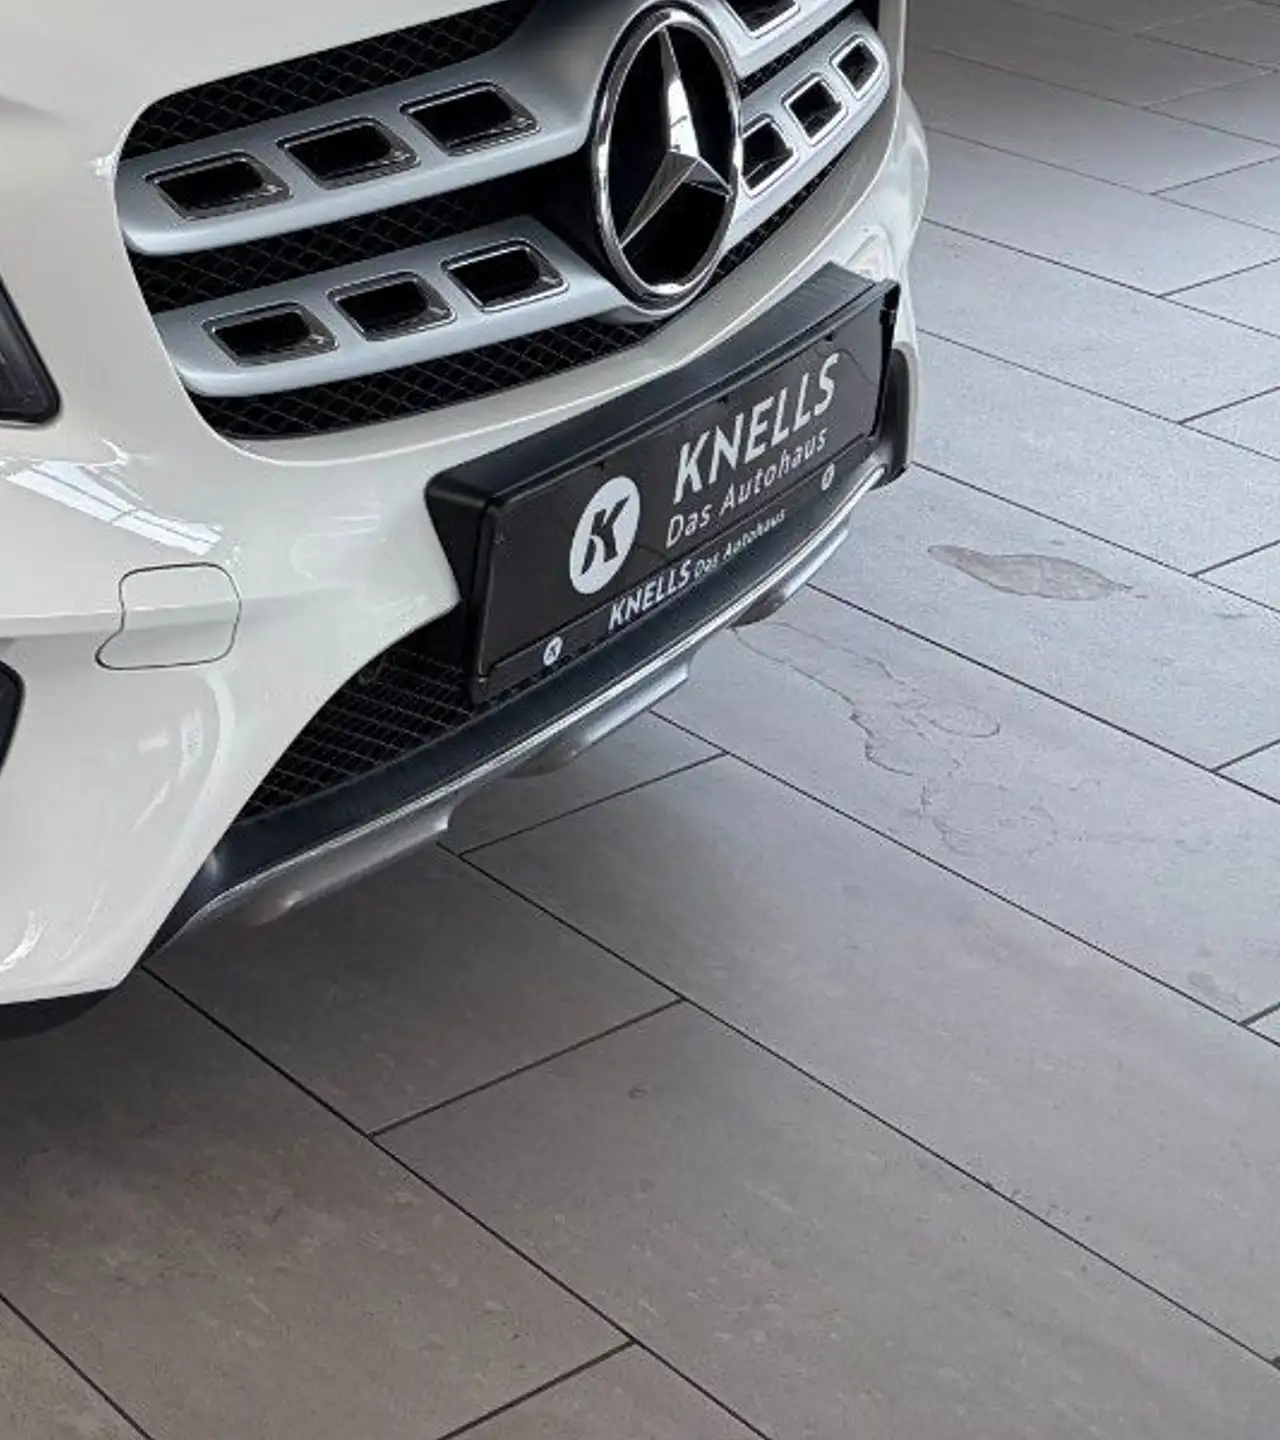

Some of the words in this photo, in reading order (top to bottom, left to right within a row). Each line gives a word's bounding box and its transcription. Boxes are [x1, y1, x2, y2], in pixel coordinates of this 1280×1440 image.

[666, 504, 713, 549] Das
[718, 427, 828, 517] Autohaus
[673, 353, 839, 505] KNELLS
[578, 492, 632, 578] K
[608, 559, 691, 634] KNELLS
[694, 550, 721, 579] Das
[722, 509, 786, 561] Autohaus
